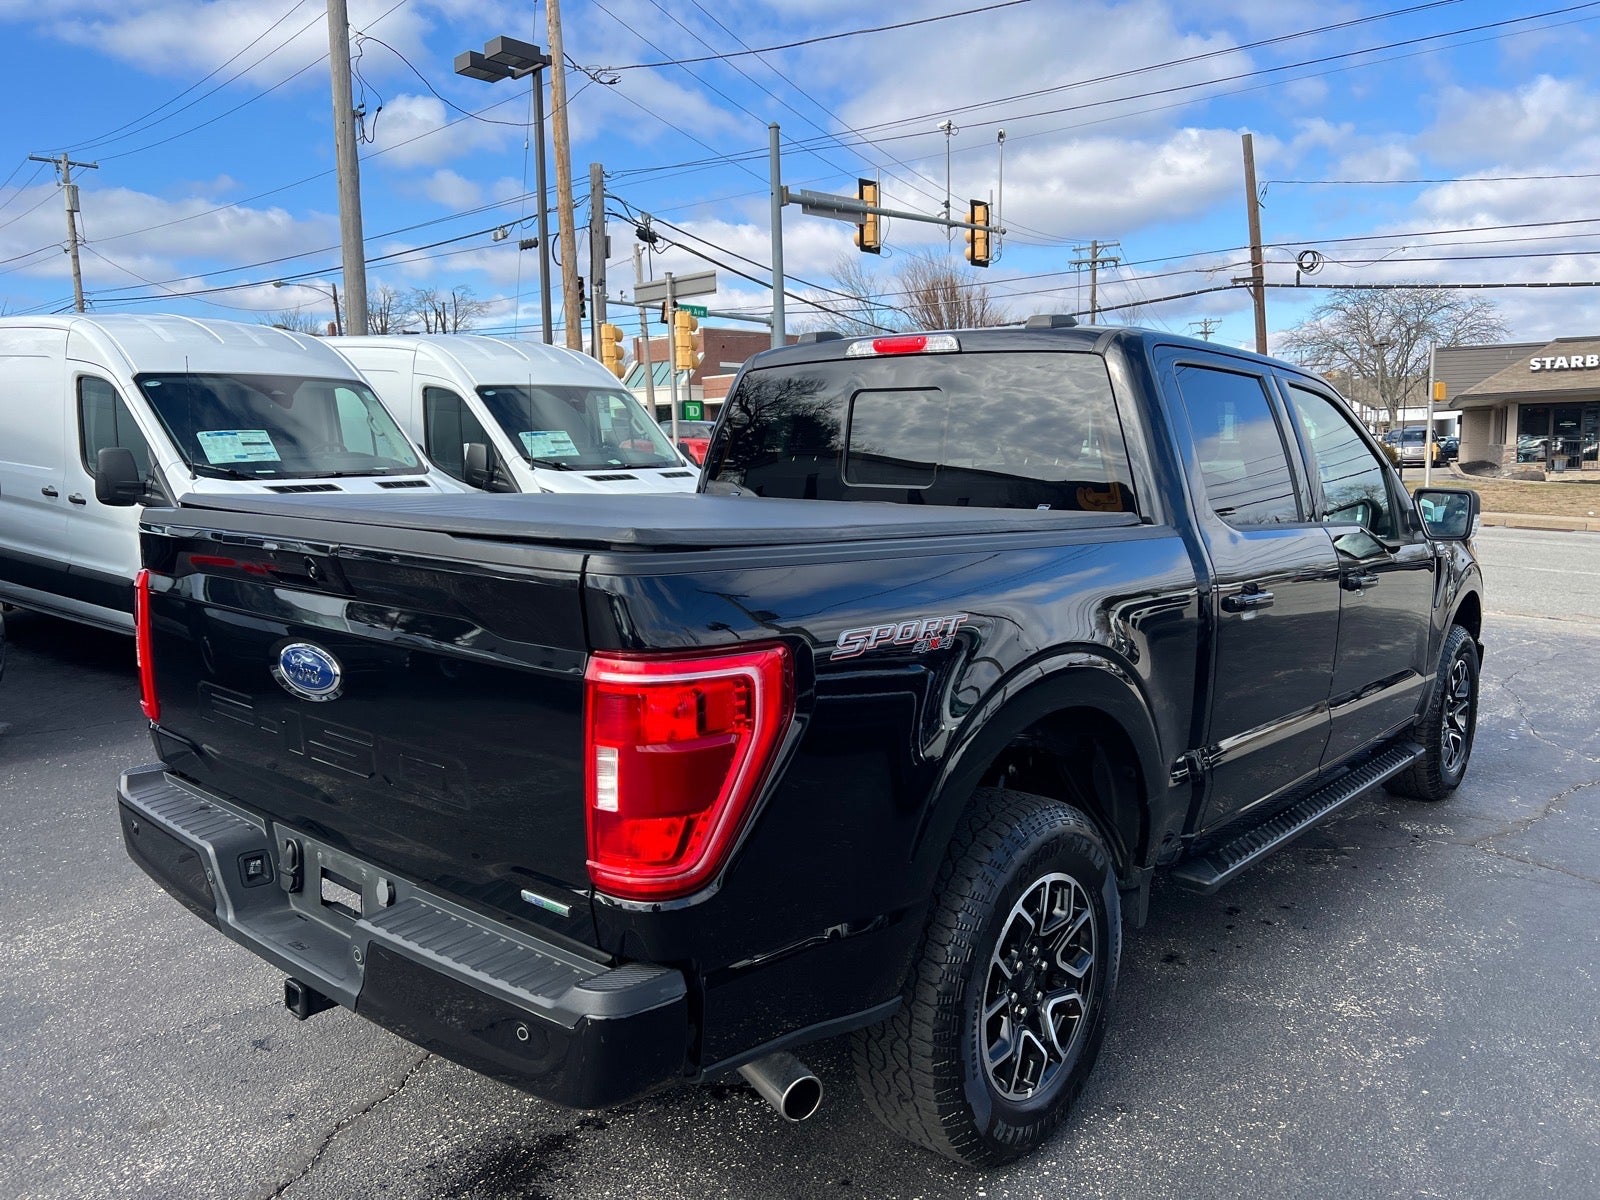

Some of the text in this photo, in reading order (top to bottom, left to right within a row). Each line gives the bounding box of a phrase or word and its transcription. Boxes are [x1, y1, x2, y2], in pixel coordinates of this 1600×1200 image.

[693, 308, 705, 316] Ave
[1530, 355, 1599, 371] STARB
[687, 405, 700, 417] TD
[830, 614, 969, 661] SPORT
